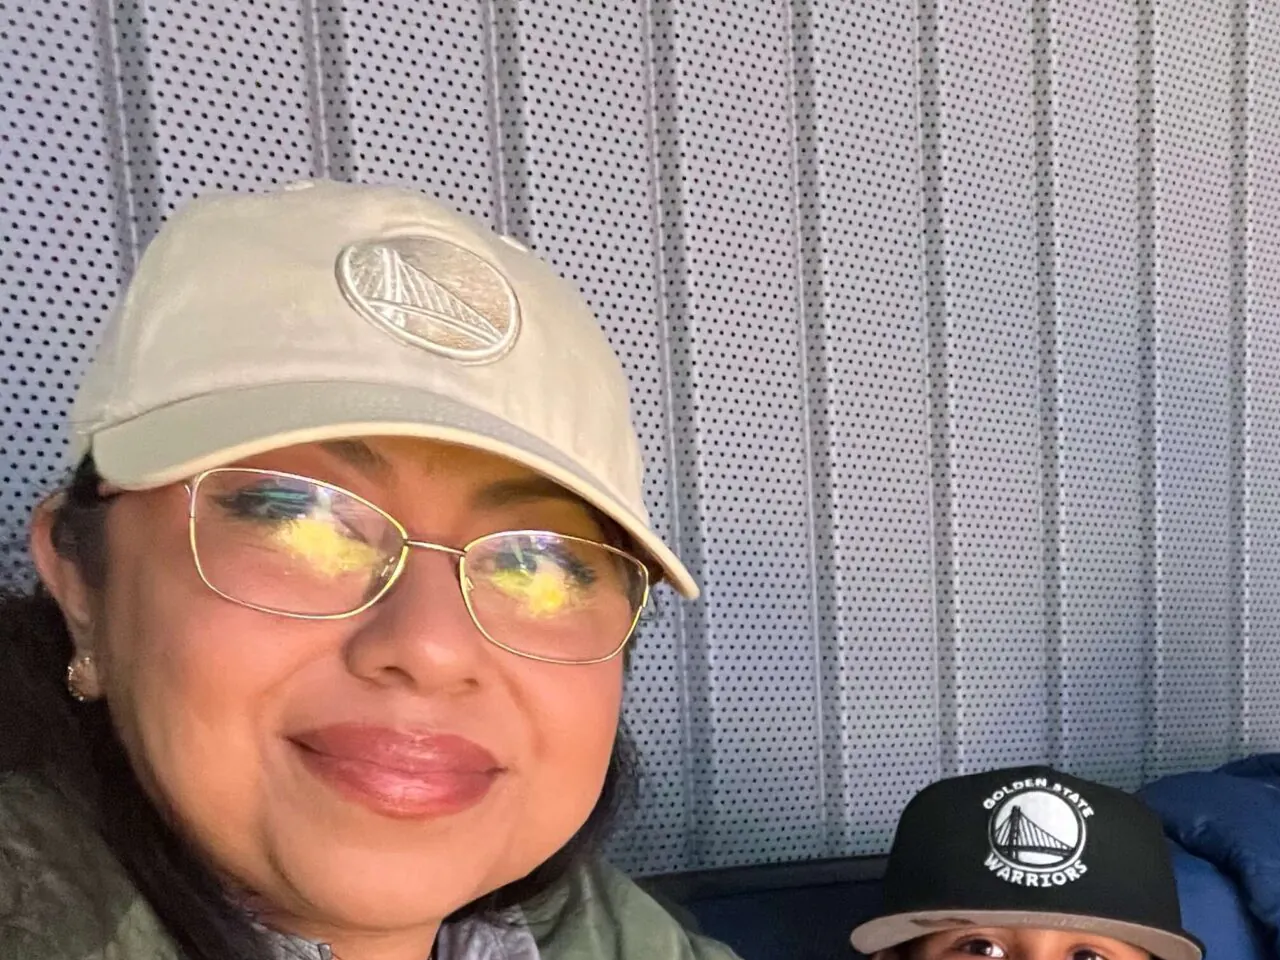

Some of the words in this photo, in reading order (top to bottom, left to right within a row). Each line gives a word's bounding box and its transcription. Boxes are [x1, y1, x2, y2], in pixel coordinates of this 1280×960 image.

[983, 777, 1047, 810] GOLDEN
[1049, 783, 1095, 819] STATE
[983, 851, 1088, 887] WARRIORS
